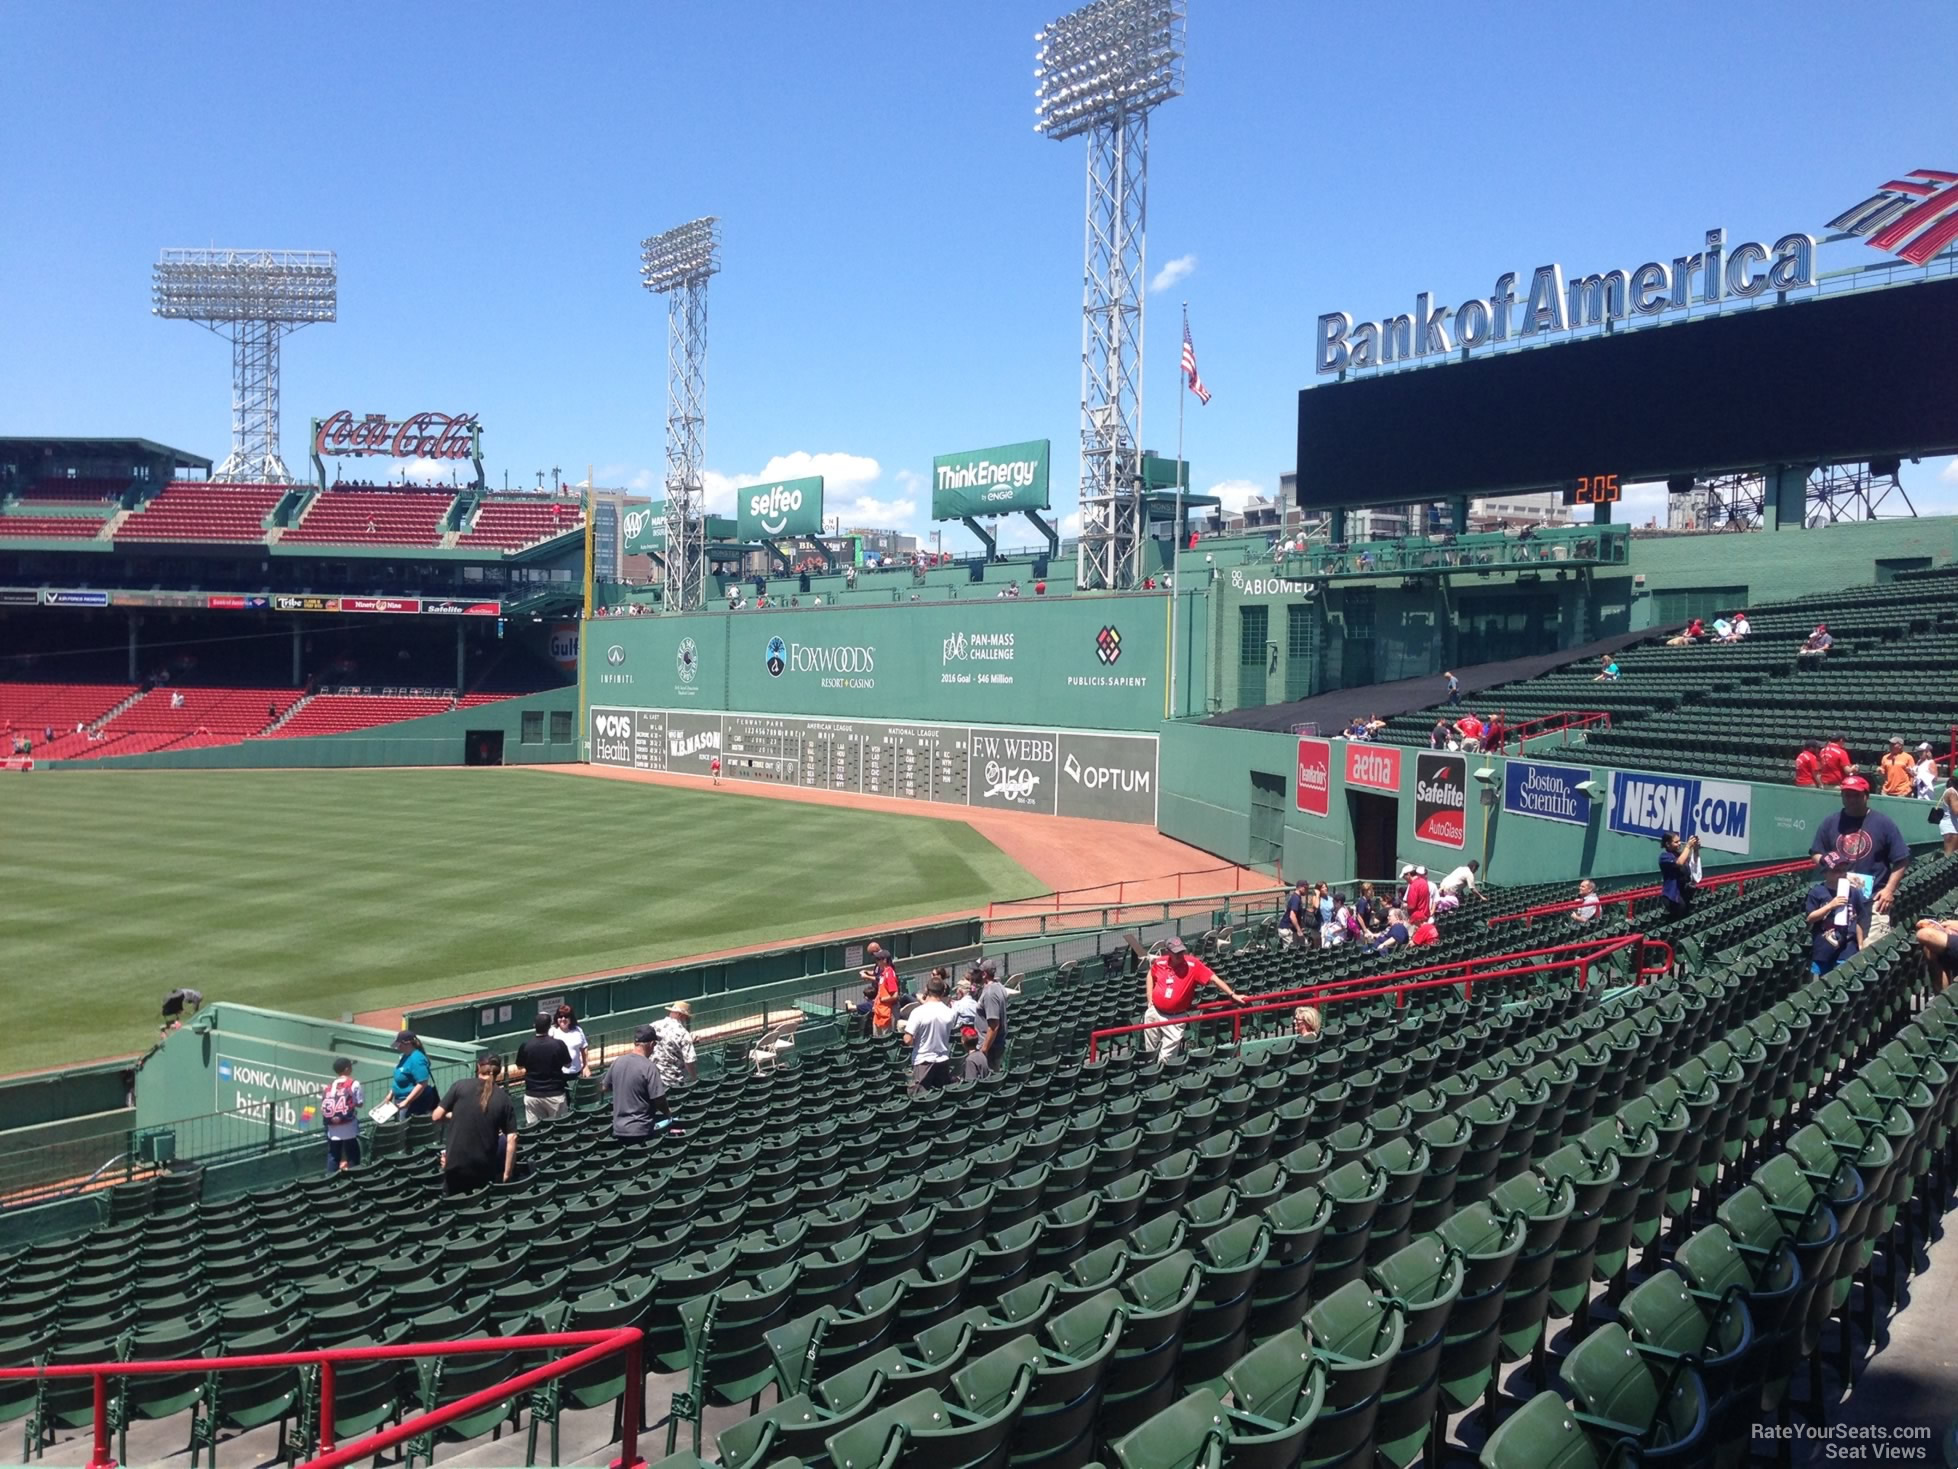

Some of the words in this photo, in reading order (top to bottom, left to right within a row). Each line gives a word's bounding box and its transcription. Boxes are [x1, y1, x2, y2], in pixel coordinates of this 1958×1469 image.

[1315, 291, 1452, 375] Bank
[1454, 271, 1521, 349] of
[1521, 228, 1817, 337] America
[316, 410, 479, 460] Coca-Cola
[1576, 474, 1618, 504] 2:05
[278, 597, 302, 608] Tribe
[355, 601, 376, 609] Ninety
[427, 605, 463, 613] Safelite
[551, 637, 578, 656] Gulf
[971, 633, 1014, 646] PAN-MASS
[790, 643, 875, 673] FOXWOODS
[970, 648, 1014, 660] CHALLENGE
[601, 674, 634, 684] INFINITI
[821, 678, 844, 688] RESORT
[849, 678, 874, 688] CASINO
[941, 673, 956, 683] 2016
[957, 674, 970, 683] Goal
[977, 673, 989, 683] $46
[990, 674, 1013, 684] Million
[1067, 676, 1147, 687] PUBLICIS.SAPIENT
[606, 715, 631, 738] CVS
[807, 723, 831, 732] AMERICAN
[888, 728, 915, 737] NATIONAL
[917, 729, 940, 738] LEAGUE
[596, 738, 631, 761] Health
[973, 737, 1000, 760] F.W.
[1004, 738, 1053, 762] WEBB
[1083, 766, 1150, 793] OPTUM
[1352, 752, 1391, 785] aetna
[1527, 766, 1564, 793] Boston
[1417, 780, 1464, 807] Safelite
[1520, 781, 1577, 817] Scientific
[1622, 780, 1685, 833] NESN
[1428, 820, 1463, 840] AutoGlass
[1792, 819, 1806, 831] 40
[233, 1065, 280, 1091] KONICA
[321, 1095, 349, 1118] 34
